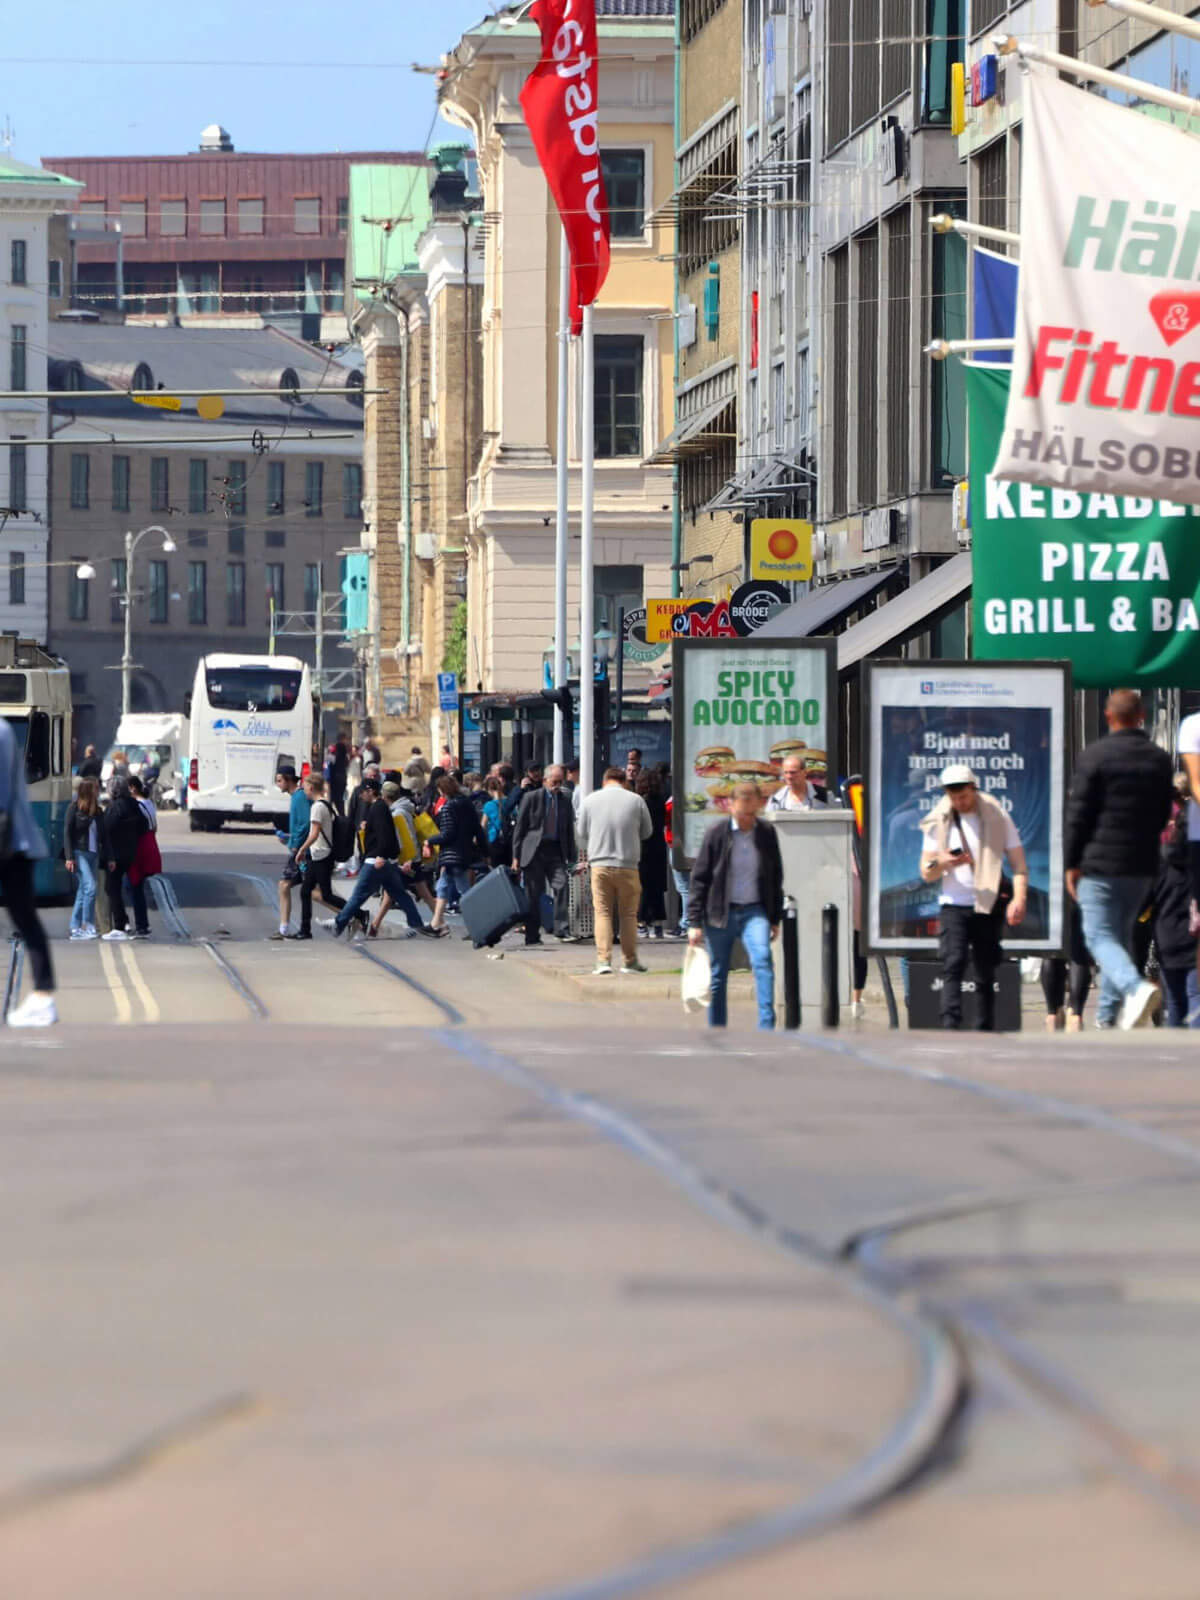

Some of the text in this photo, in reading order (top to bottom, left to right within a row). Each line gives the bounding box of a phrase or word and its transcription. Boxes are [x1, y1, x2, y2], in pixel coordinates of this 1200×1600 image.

[1062, 195, 1200, 282] Häl
[1163, 303, 1190, 331] &
[1011, 425, 1200, 481] HÄLSOB
[1041, 541, 1170, 582] PIZZA
[984, 597, 1095, 635] GRILL
[1108, 596, 1137, 632] &
[718, 671, 795, 697] SPICY
[693, 699, 820, 726] AVOCADO
[924, 732, 1011, 753] Bjud med
[989, 753, 1024, 770] och
